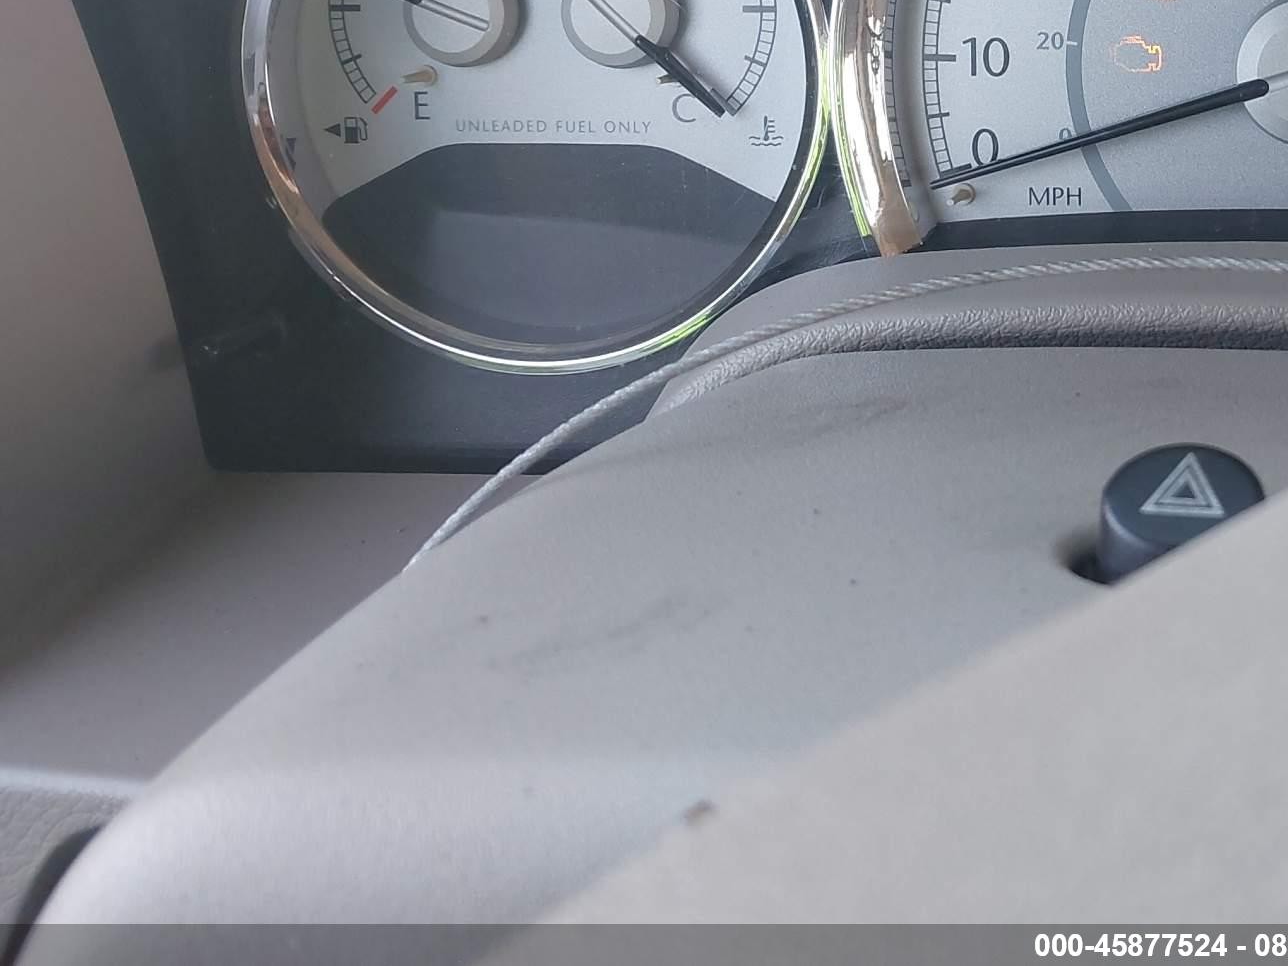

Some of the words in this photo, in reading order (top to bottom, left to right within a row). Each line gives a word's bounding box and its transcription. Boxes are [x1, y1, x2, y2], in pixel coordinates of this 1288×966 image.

[1037, 33, 1064, 51] 20
[963, 38, 1009, 77] 10
[414, 92, 430, 120] E
[672, 94, 696, 123] C
[456, 119, 546, 133] UNLEADED
[556, 120, 595, 133] FUEL
[604, 121, 650, 133] ONLY
[972, 129, 999, 167] 0
[1029, 187, 1081, 206] MPH
